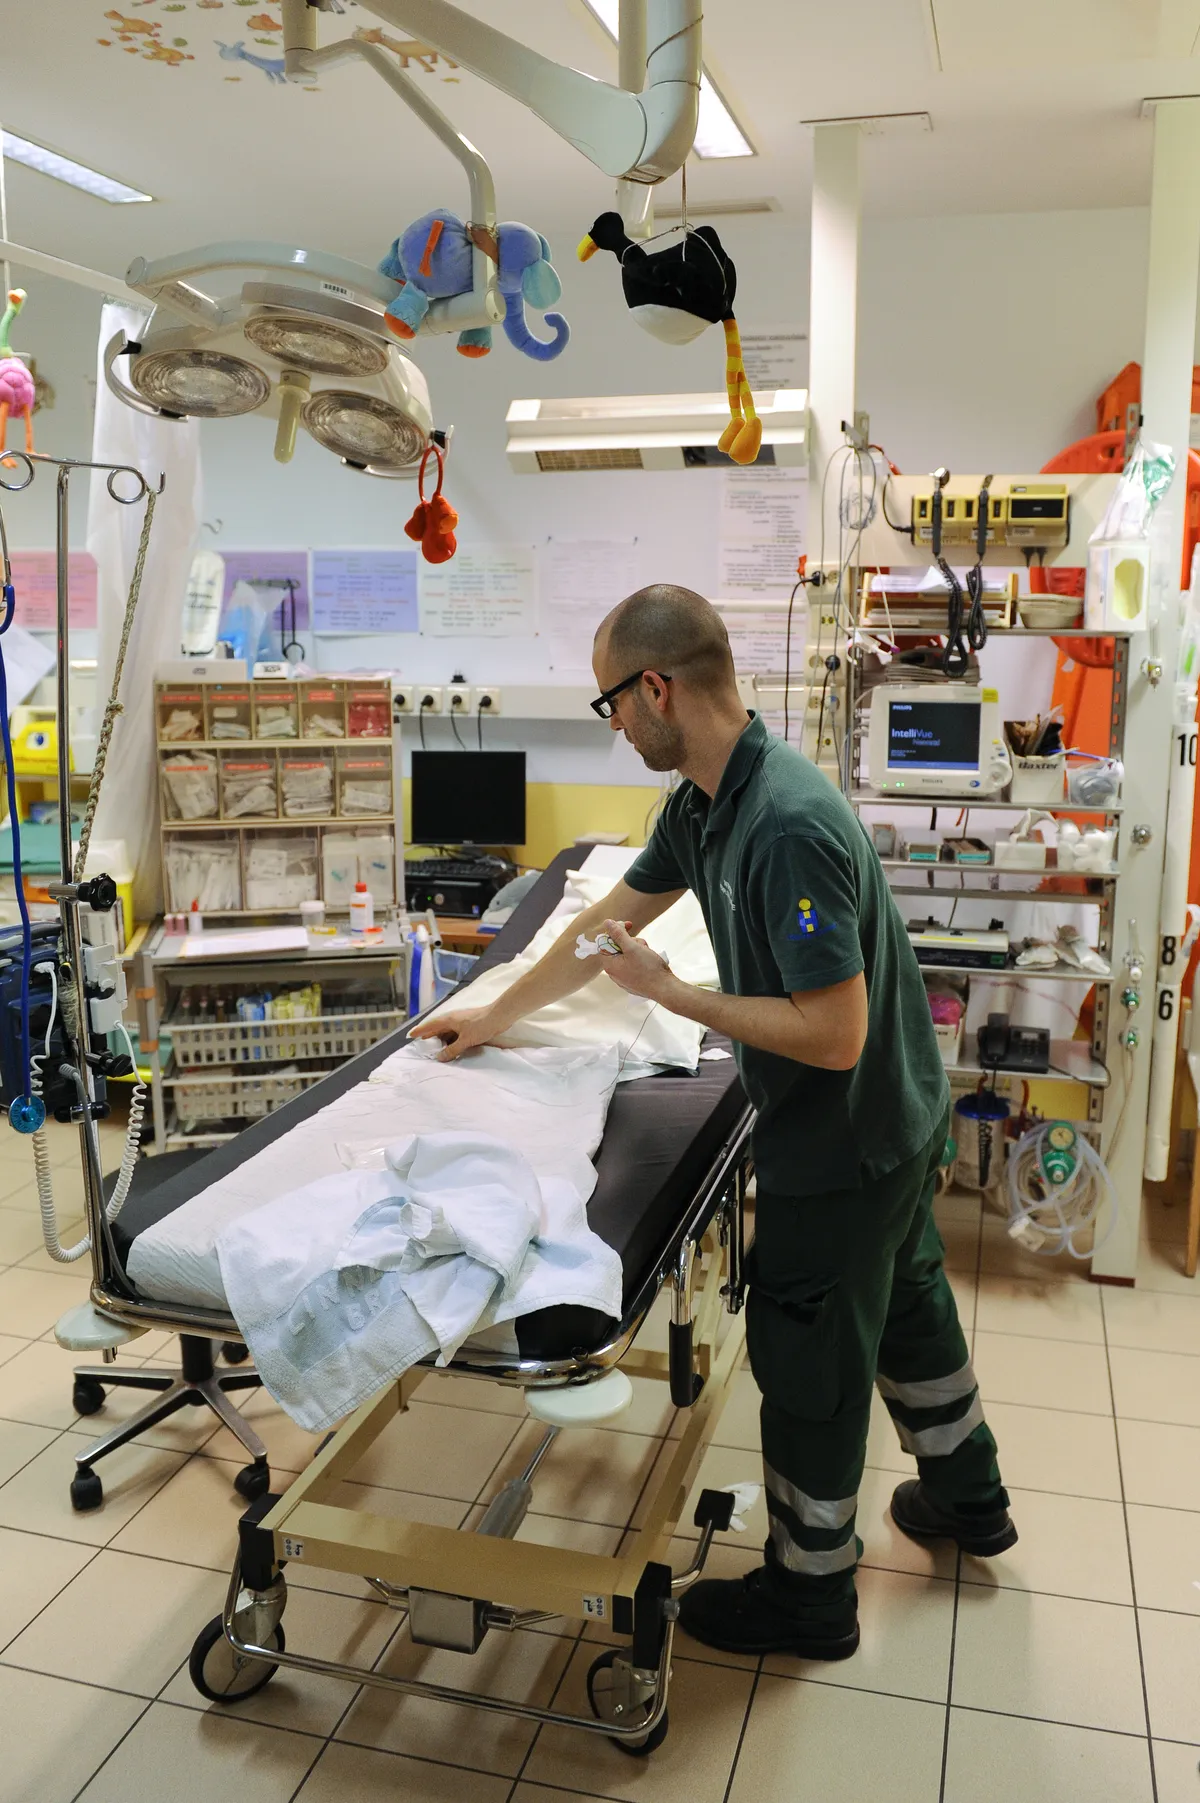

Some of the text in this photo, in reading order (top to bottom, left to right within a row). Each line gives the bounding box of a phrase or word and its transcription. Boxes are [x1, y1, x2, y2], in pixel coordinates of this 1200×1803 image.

[891, 728, 933, 738] IntelliVue
[1177, 733, 1198, 766] 10
[1018, 761, 1059, 770] Baxter
[1161, 935, 1176, 965] 8
[1158, 989, 1174, 1021] 6
